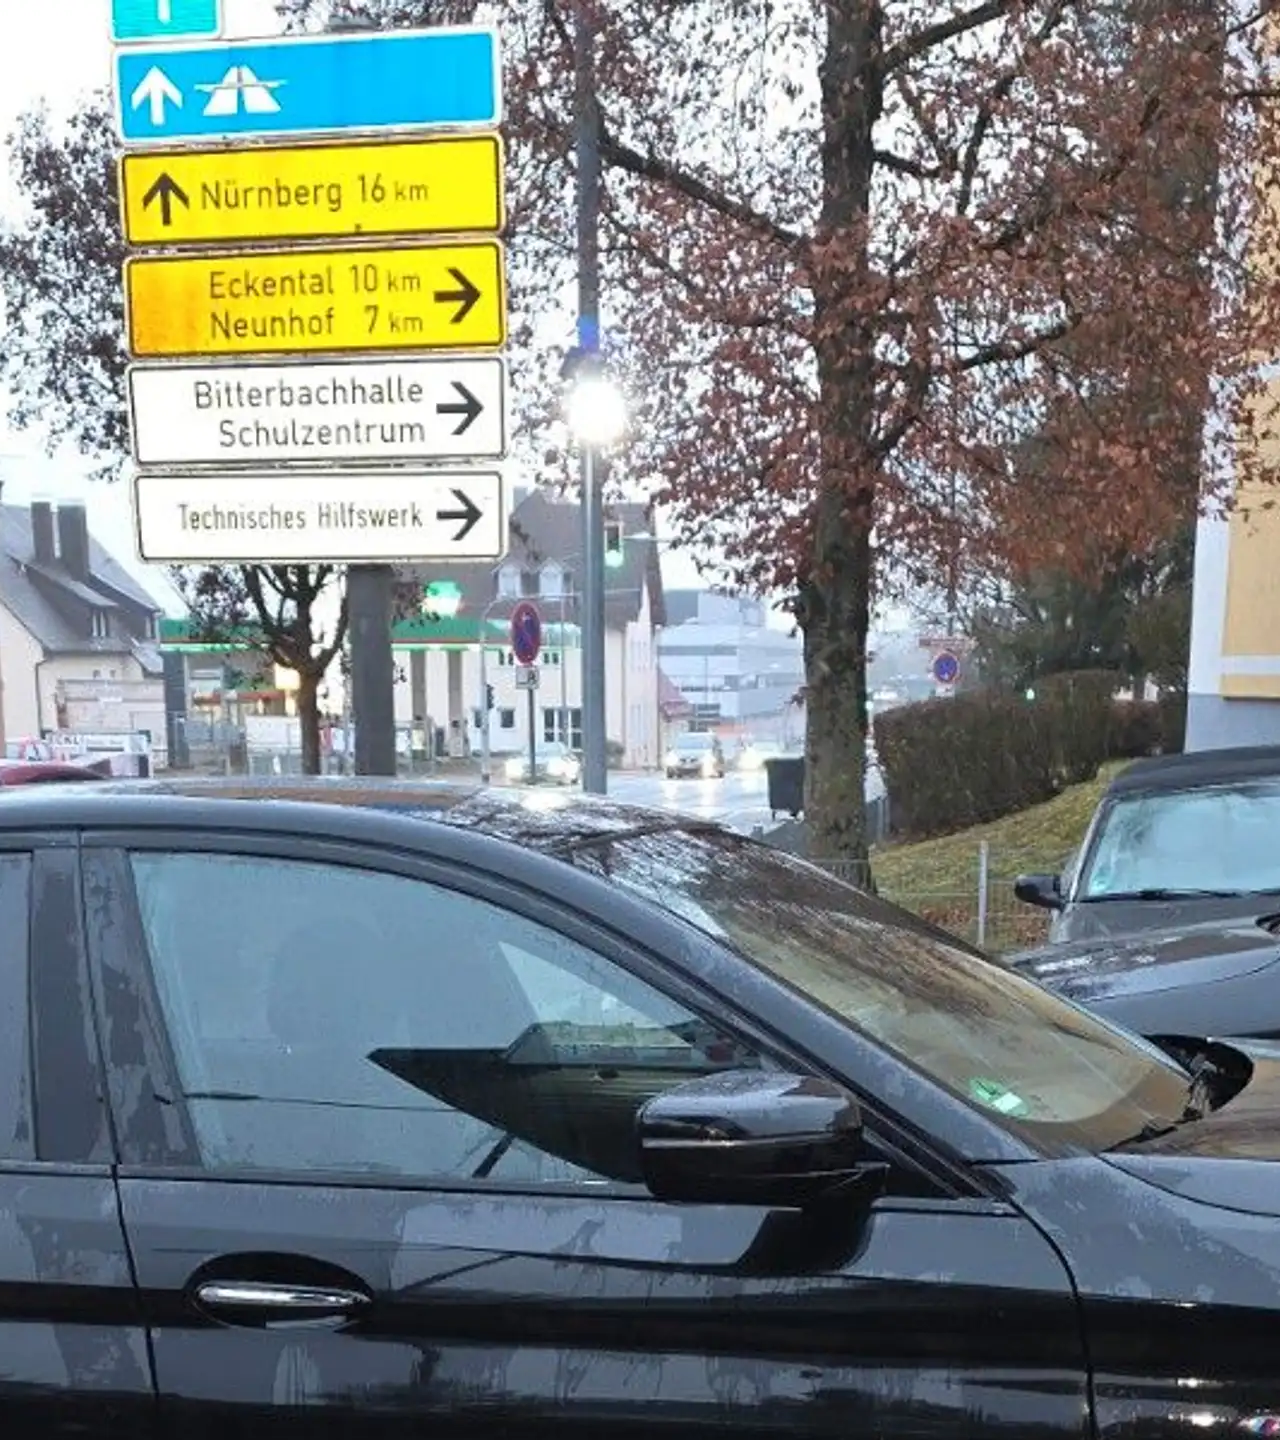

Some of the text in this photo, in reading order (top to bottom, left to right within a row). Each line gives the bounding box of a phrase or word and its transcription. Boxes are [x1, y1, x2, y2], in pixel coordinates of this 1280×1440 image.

[201, 173, 429, 212] Nürnberg 16 km
[209, 264, 421, 299] Eckental 10 km
[210, 306, 424, 340] Neunhof 7 km
[194, 375, 423, 410] Bitterbachhalle
[219, 419, 426, 448] Schulzentrum
[178, 502, 424, 531] Technisches Hilfswerk
